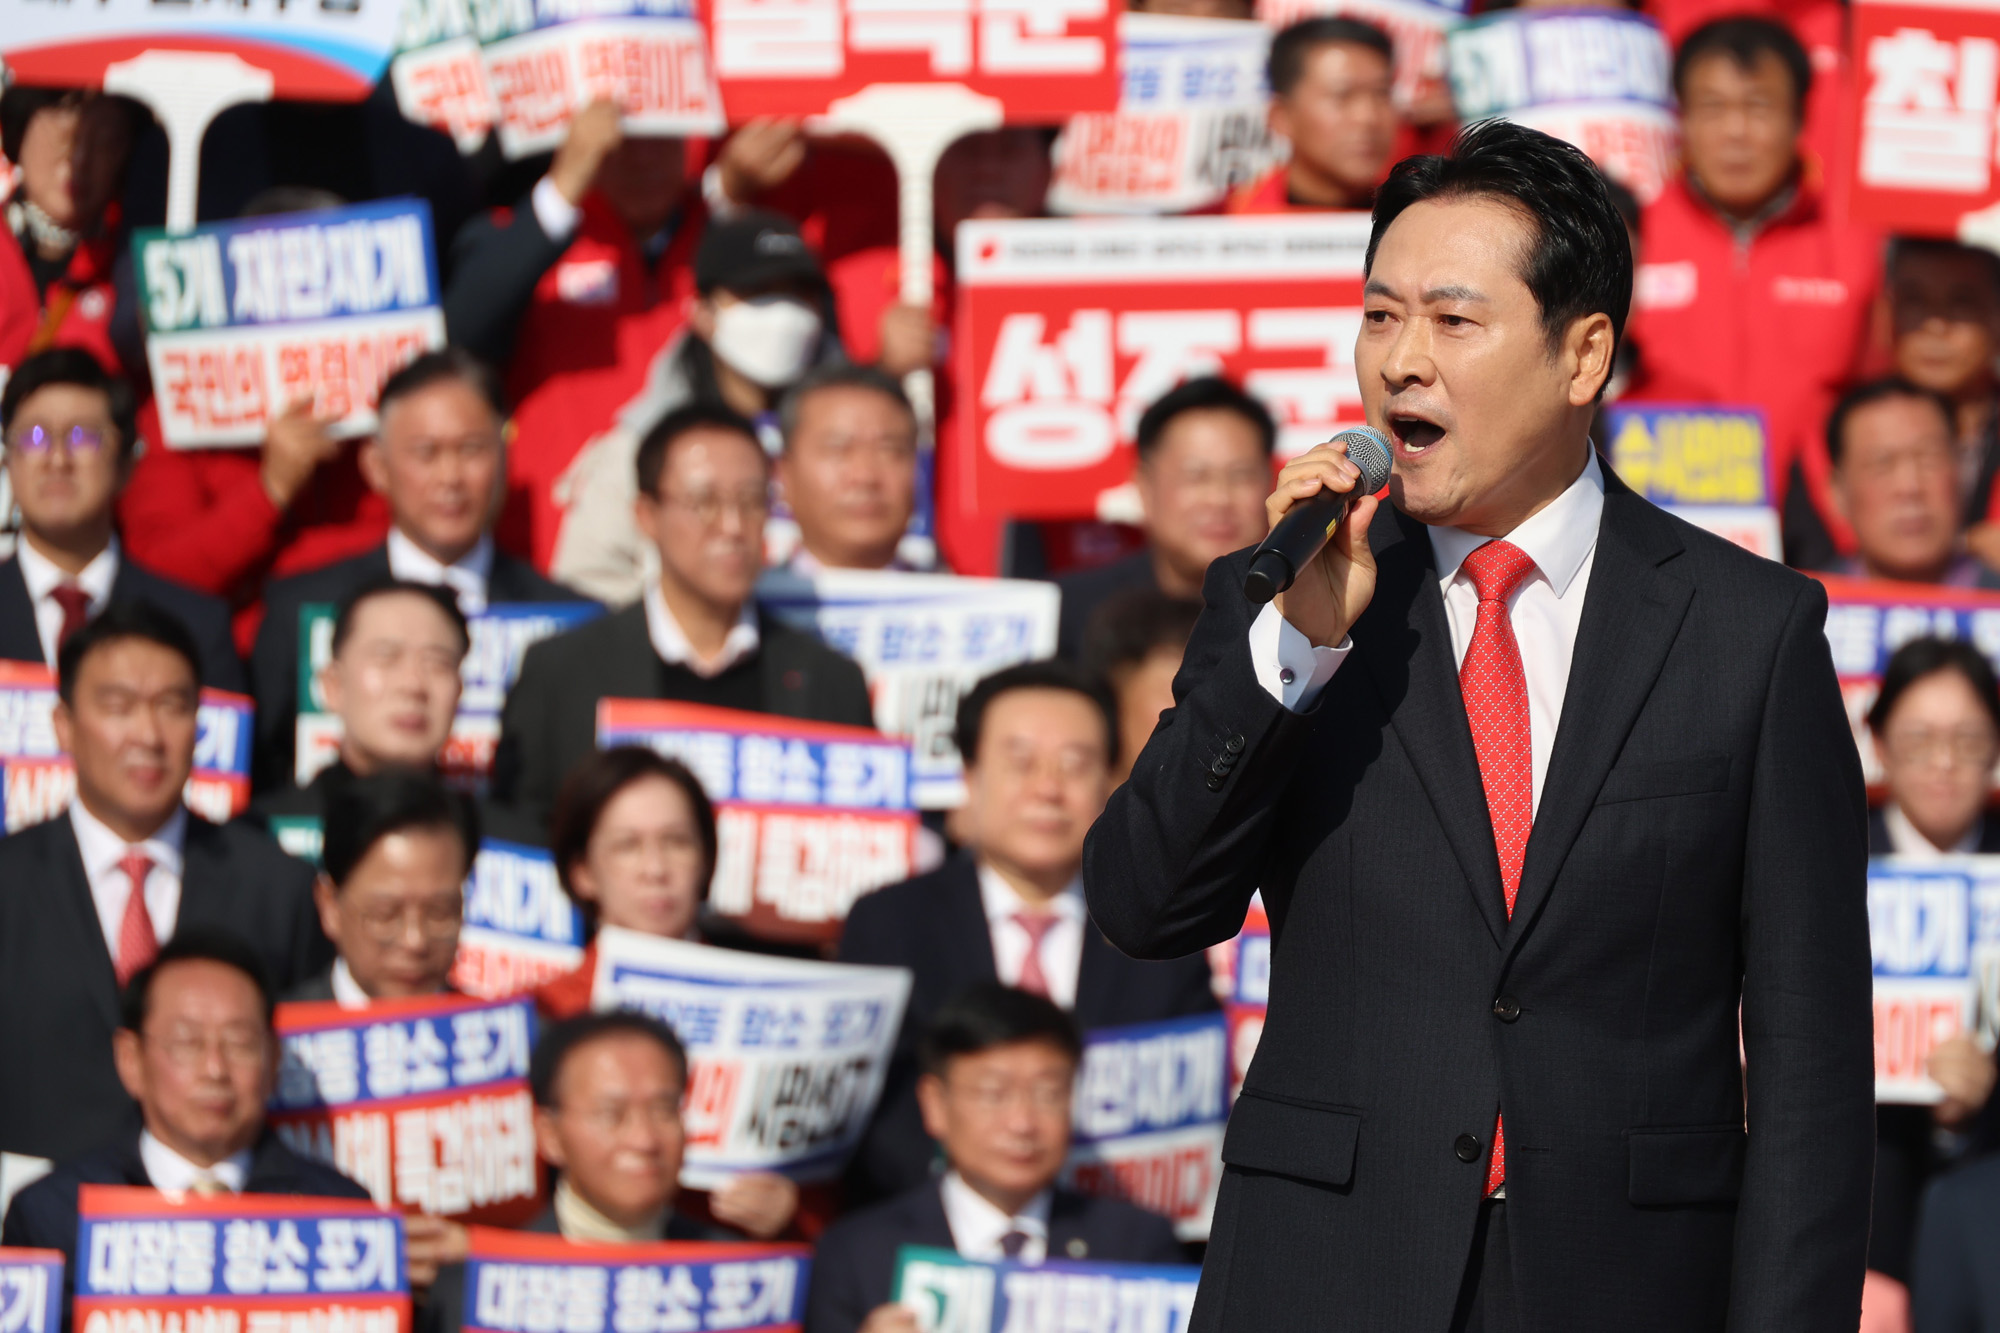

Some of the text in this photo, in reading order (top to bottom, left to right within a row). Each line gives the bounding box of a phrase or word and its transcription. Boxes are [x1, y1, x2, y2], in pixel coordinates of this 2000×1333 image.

[142, 213, 430, 332] 5개 재판재개
[736, 735, 821, 803] 항소
[822, 742, 908, 808] 포기
[363, 1018, 450, 1098] 항소
[451, 1003, 531, 1085] 포기
[1078, 1025, 1224, 1138] 판재개
[88, 1217, 398, 1295] 대장동 항소 포기
[476, 1262, 609, 1333] 대장동
[613, 1263, 701, 1333] 항소
[703, 1256, 798, 1329] 포기
[902, 1260, 996, 1333] 5개
